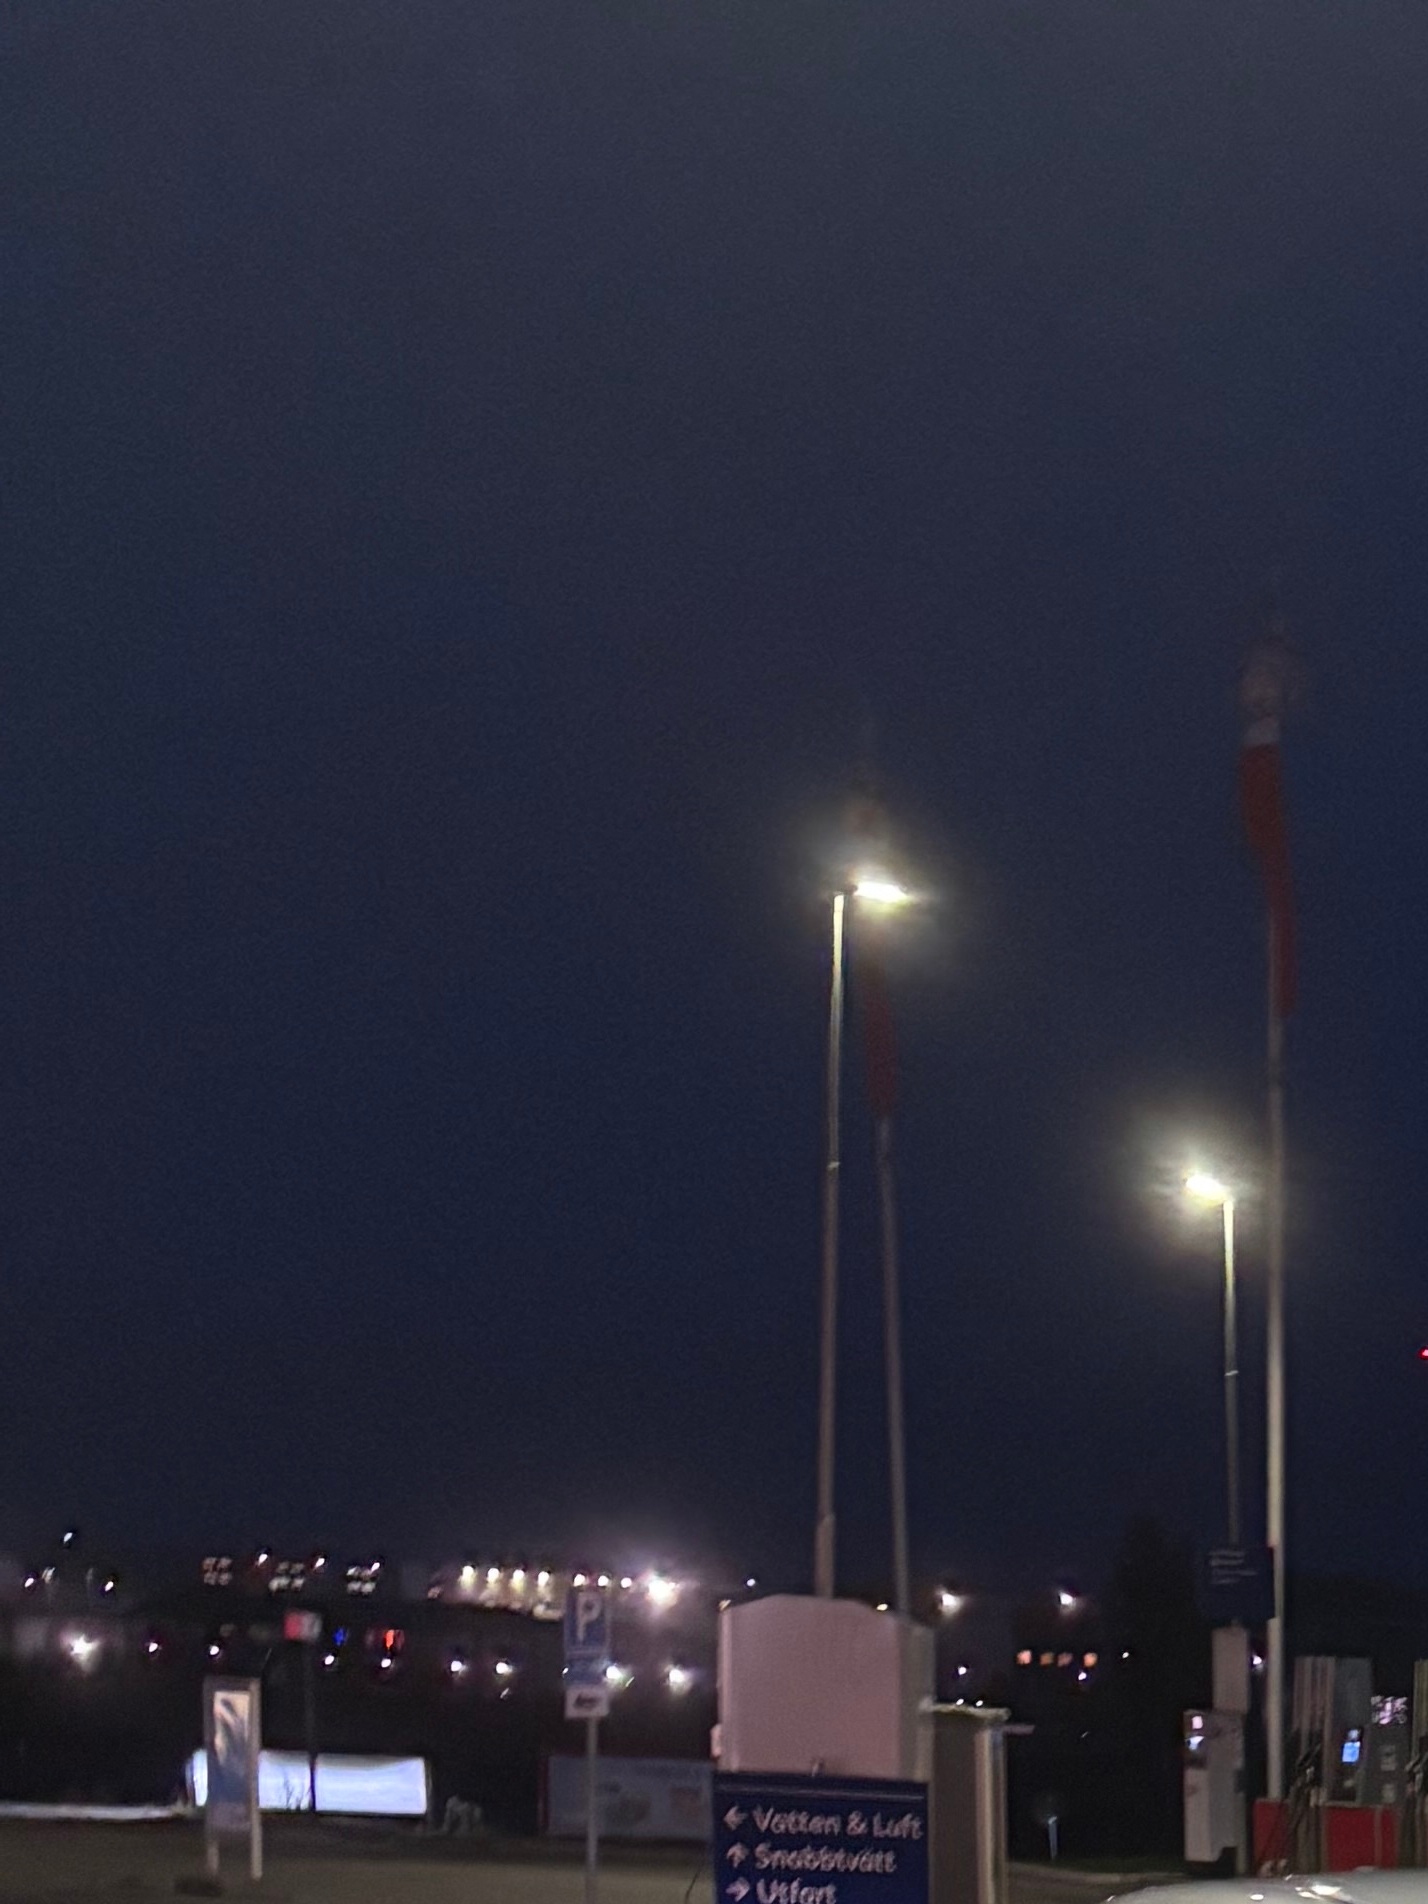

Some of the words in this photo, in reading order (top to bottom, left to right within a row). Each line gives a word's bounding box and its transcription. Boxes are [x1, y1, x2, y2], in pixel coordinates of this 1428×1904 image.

[577, 1591, 602, 1641] P
[752, 1804, 841, 1836] Vatten
[847, 1810, 868, 1836] &
[872, 1811, 924, 1840] Luft
[753, 1841, 897, 1873] Snabbtvätt
